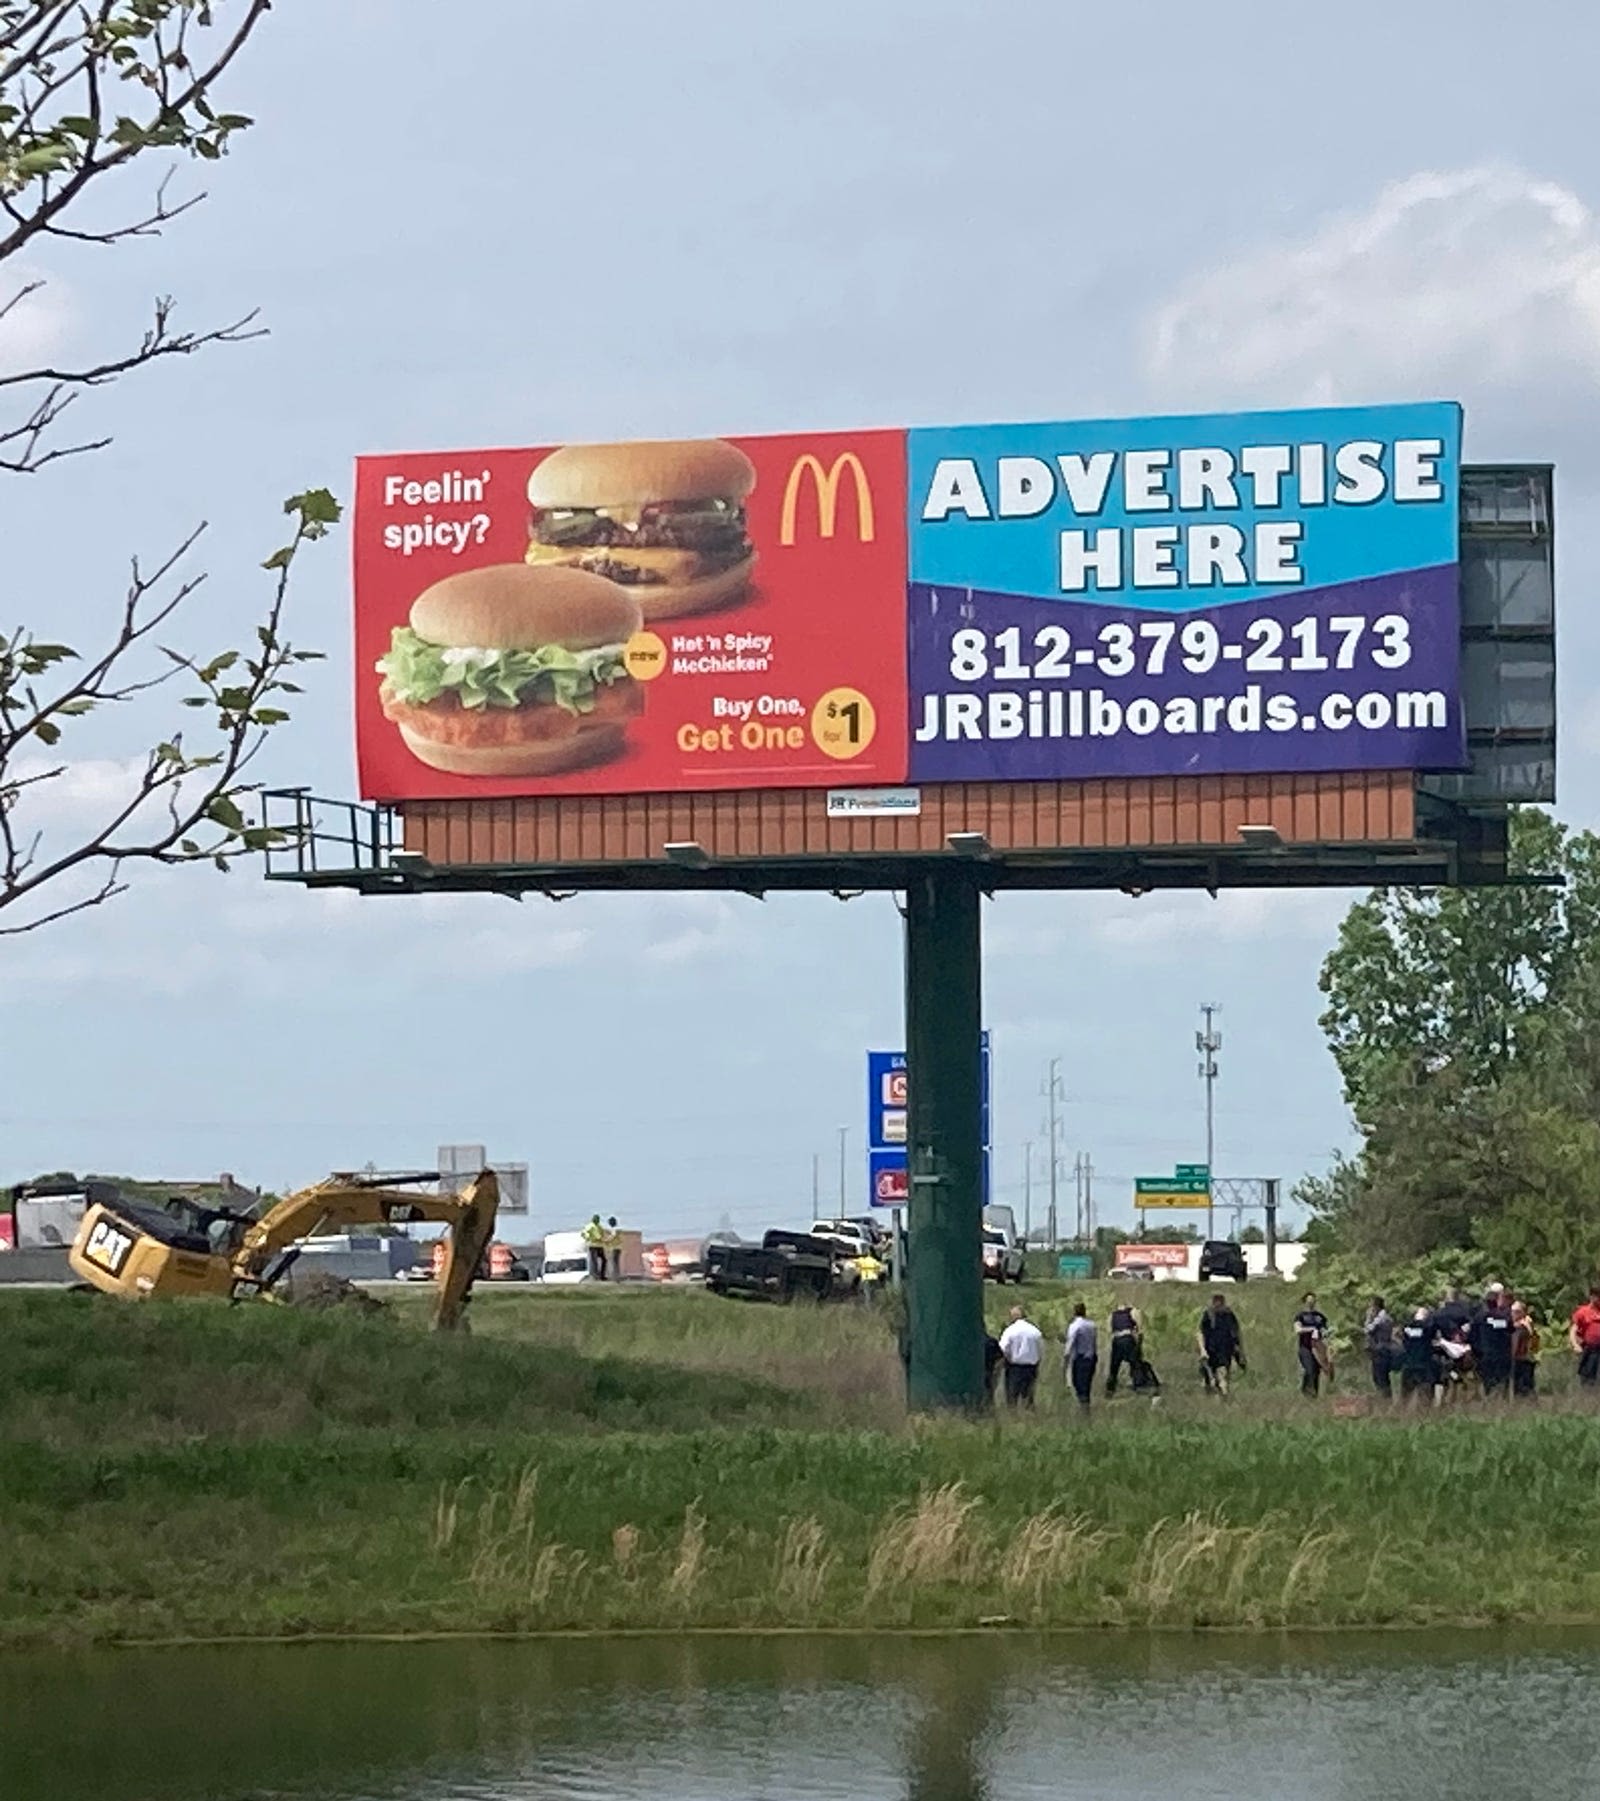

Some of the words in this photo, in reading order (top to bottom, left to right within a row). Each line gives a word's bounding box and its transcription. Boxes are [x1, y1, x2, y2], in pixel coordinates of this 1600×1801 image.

[922, 439, 1442, 520] ADVERTISE
[384, 513, 490, 556] spicy?
[1060, 522, 1302, 591] HERE
[672, 636, 704, 652] Hot
[724, 631, 772, 654] Spicy
[950, 614, 1412, 682] 812-379-2173
[713, 697, 753, 721] Buy
[756, 695, 806, 717] One,
[915, 685, 1447, 743] JRBillboards.com
[677, 723, 735, 751] Get
[740, 722, 804, 750] One
[86, 1222, 133, 1272] CAT
